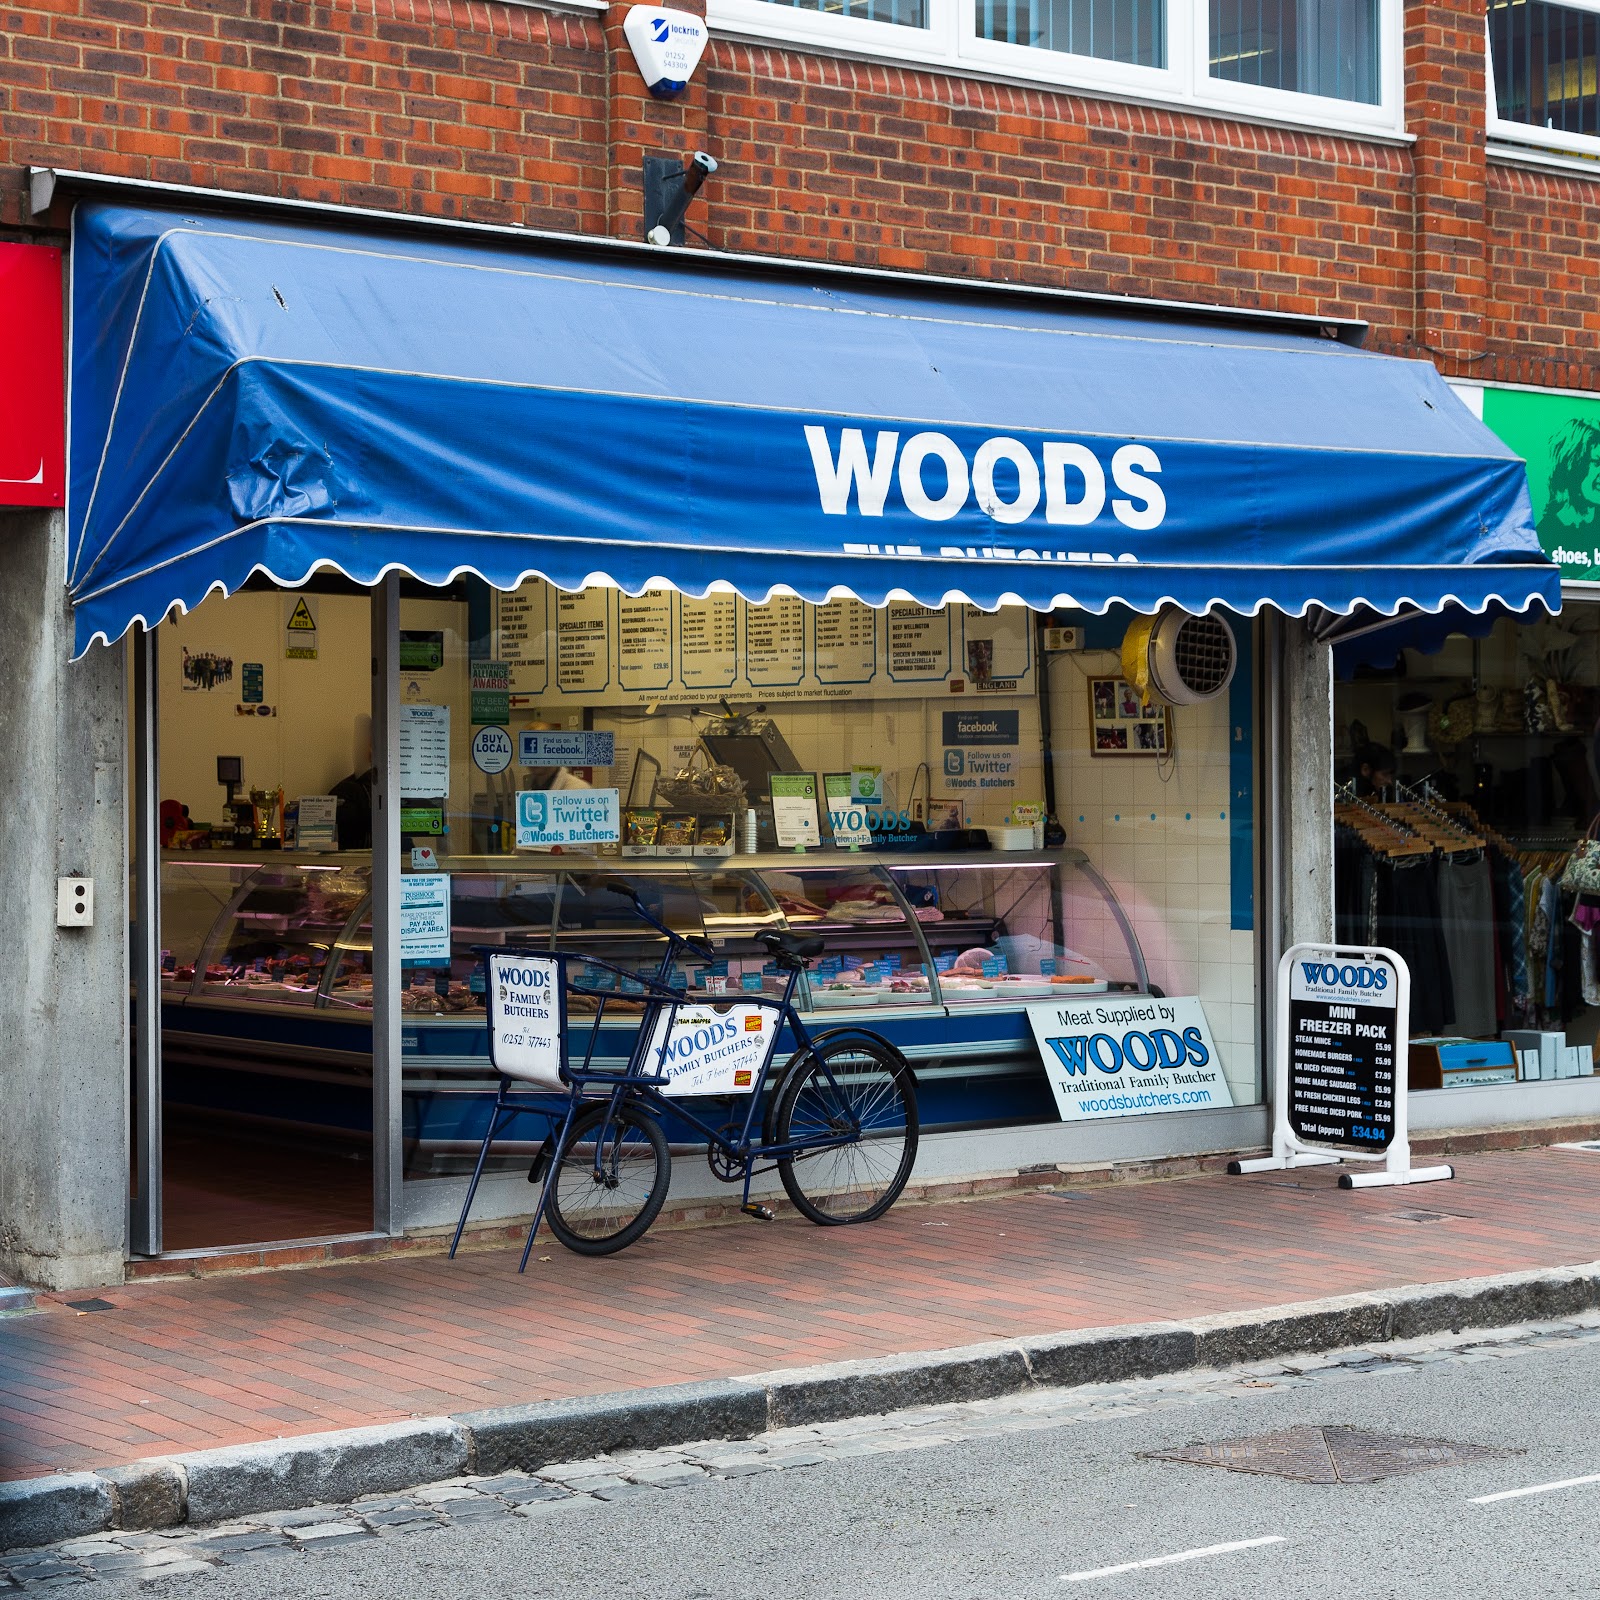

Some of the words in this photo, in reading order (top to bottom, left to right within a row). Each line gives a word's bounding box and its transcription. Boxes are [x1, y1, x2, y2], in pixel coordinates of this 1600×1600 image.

[671, 24, 699, 36] lockrite
[665, 51, 685, 60] 01252
[663, 60, 688, 70] 543309
[803, 425, 1167, 531] WOODS
[1551, 545, 1592, 568] shoes,
[892, 608, 924, 617] SPECIALIST
[559, 621, 586, 630] SPECIALIST
[588, 620, 604, 628] ITEMS
[473, 670, 508, 678] ALLIANCE
[473, 678, 508, 689] AWARDS
[978, 681, 1016, 689] ENGLAND
[473, 697, 486, 705] I'VE
[488, 697, 508, 705] BEEN
[680, 694, 699, 702] packed
[706, 693, 717, 701] your
[719, 692, 752, 701] requirements
[777, 690, 796, 698] subject
[958, 721, 998, 732] facebook
[482, 734, 503, 743] BUY
[476, 744, 508, 753] LOCAL
[968, 760, 1011, 773] Twitter
[552, 796, 582, 807] Follow
[598, 796, 609, 804] on
[553, 808, 609, 823] Twitter
[826, 810, 911, 831] WOODS
[522, 829, 614, 843] @Woods_Butchers
[820, 835, 860, 843] Traditional
[861, 835, 886, 844] Family
[888, 834, 917, 843] Butcher
[499, 967, 551, 988] WOODS
[1301, 962, 1388, 991] WOODS
[510, 991, 541, 1005] FAMILY
[1305, 985, 1336, 994] Traditional
[1338, 988, 1358, 997] Family
[1360, 989, 1382, 998] Butcher
[1316, 994, 1370, 1003] www.woodsbutchers.com
[504, 1004, 549, 1019] BUTCHERS
[1057, 1010, 1094, 1027] Meat
[1097, 1005, 1155, 1026] Supplied
[1160, 1004, 1175, 1023] by
[1329, 1005, 1356, 1020] MINI
[1300, 1018, 1352, 1036] FREEZER
[1355, 1024, 1387, 1039] PACK
[501, 1033, 525, 1046] (0252)
[527, 1035, 551, 1049] 377443
[654, 1017, 738, 1066] WOODS
[1295, 1035, 1313, 1044] STEAK
[1314, 1037, 1331, 1045] MINCE
[1375, 1043, 1392, 1051] £5.99
[667, 1057, 701, 1079] FAMILY
[704, 1037, 753, 1065] BUTCHERS
[1045, 1026, 1209, 1077] WOODS
[1295, 1049, 1326, 1059] HOMEMADE
[1327, 1052, 1352, 1062] BURGERS
[1375, 1057, 1392, 1066] £5.99
[1304, 1063, 1320, 1072] DICED
[1321, 1065, 1345, 1075] CHICKEN
[1375, 1071, 1392, 1080] £7.99
[1058, 1075, 1125, 1094] Traditional
[1129, 1073, 1170, 1091] Family
[1172, 1070, 1217, 1086] Butcher
[1295, 1076, 1311, 1085] HOME
[1312, 1078, 1328, 1087] MADE
[1329, 1080, 1356, 1090] SAUSAGES
[1375, 1085, 1392, 1094] £5.99
[1078, 1089, 1212, 1113] woodsbutchers.com
[1295, 1090, 1303, 1098] UK
[1303, 1091, 1321, 1100] FRESH
[1322, 1093, 1346, 1103] CHICKEN
[1347, 1096, 1361, 1105] LEGS
[1375, 1099, 1391, 1108] £2.99
[1295, 1104, 1309, 1112] FREE
[1310, 1105, 1328, 1115] RANGE
[1329, 1108, 1346, 1117] DICED
[1347, 1110, 1362, 1119] PORK
[1375, 1113, 1391, 1123] £5.99
[1301, 1122, 1317, 1133] Total
[1318, 1124, 1344, 1138] (approx)
[1352, 1125, 1385, 1140] £34.94
